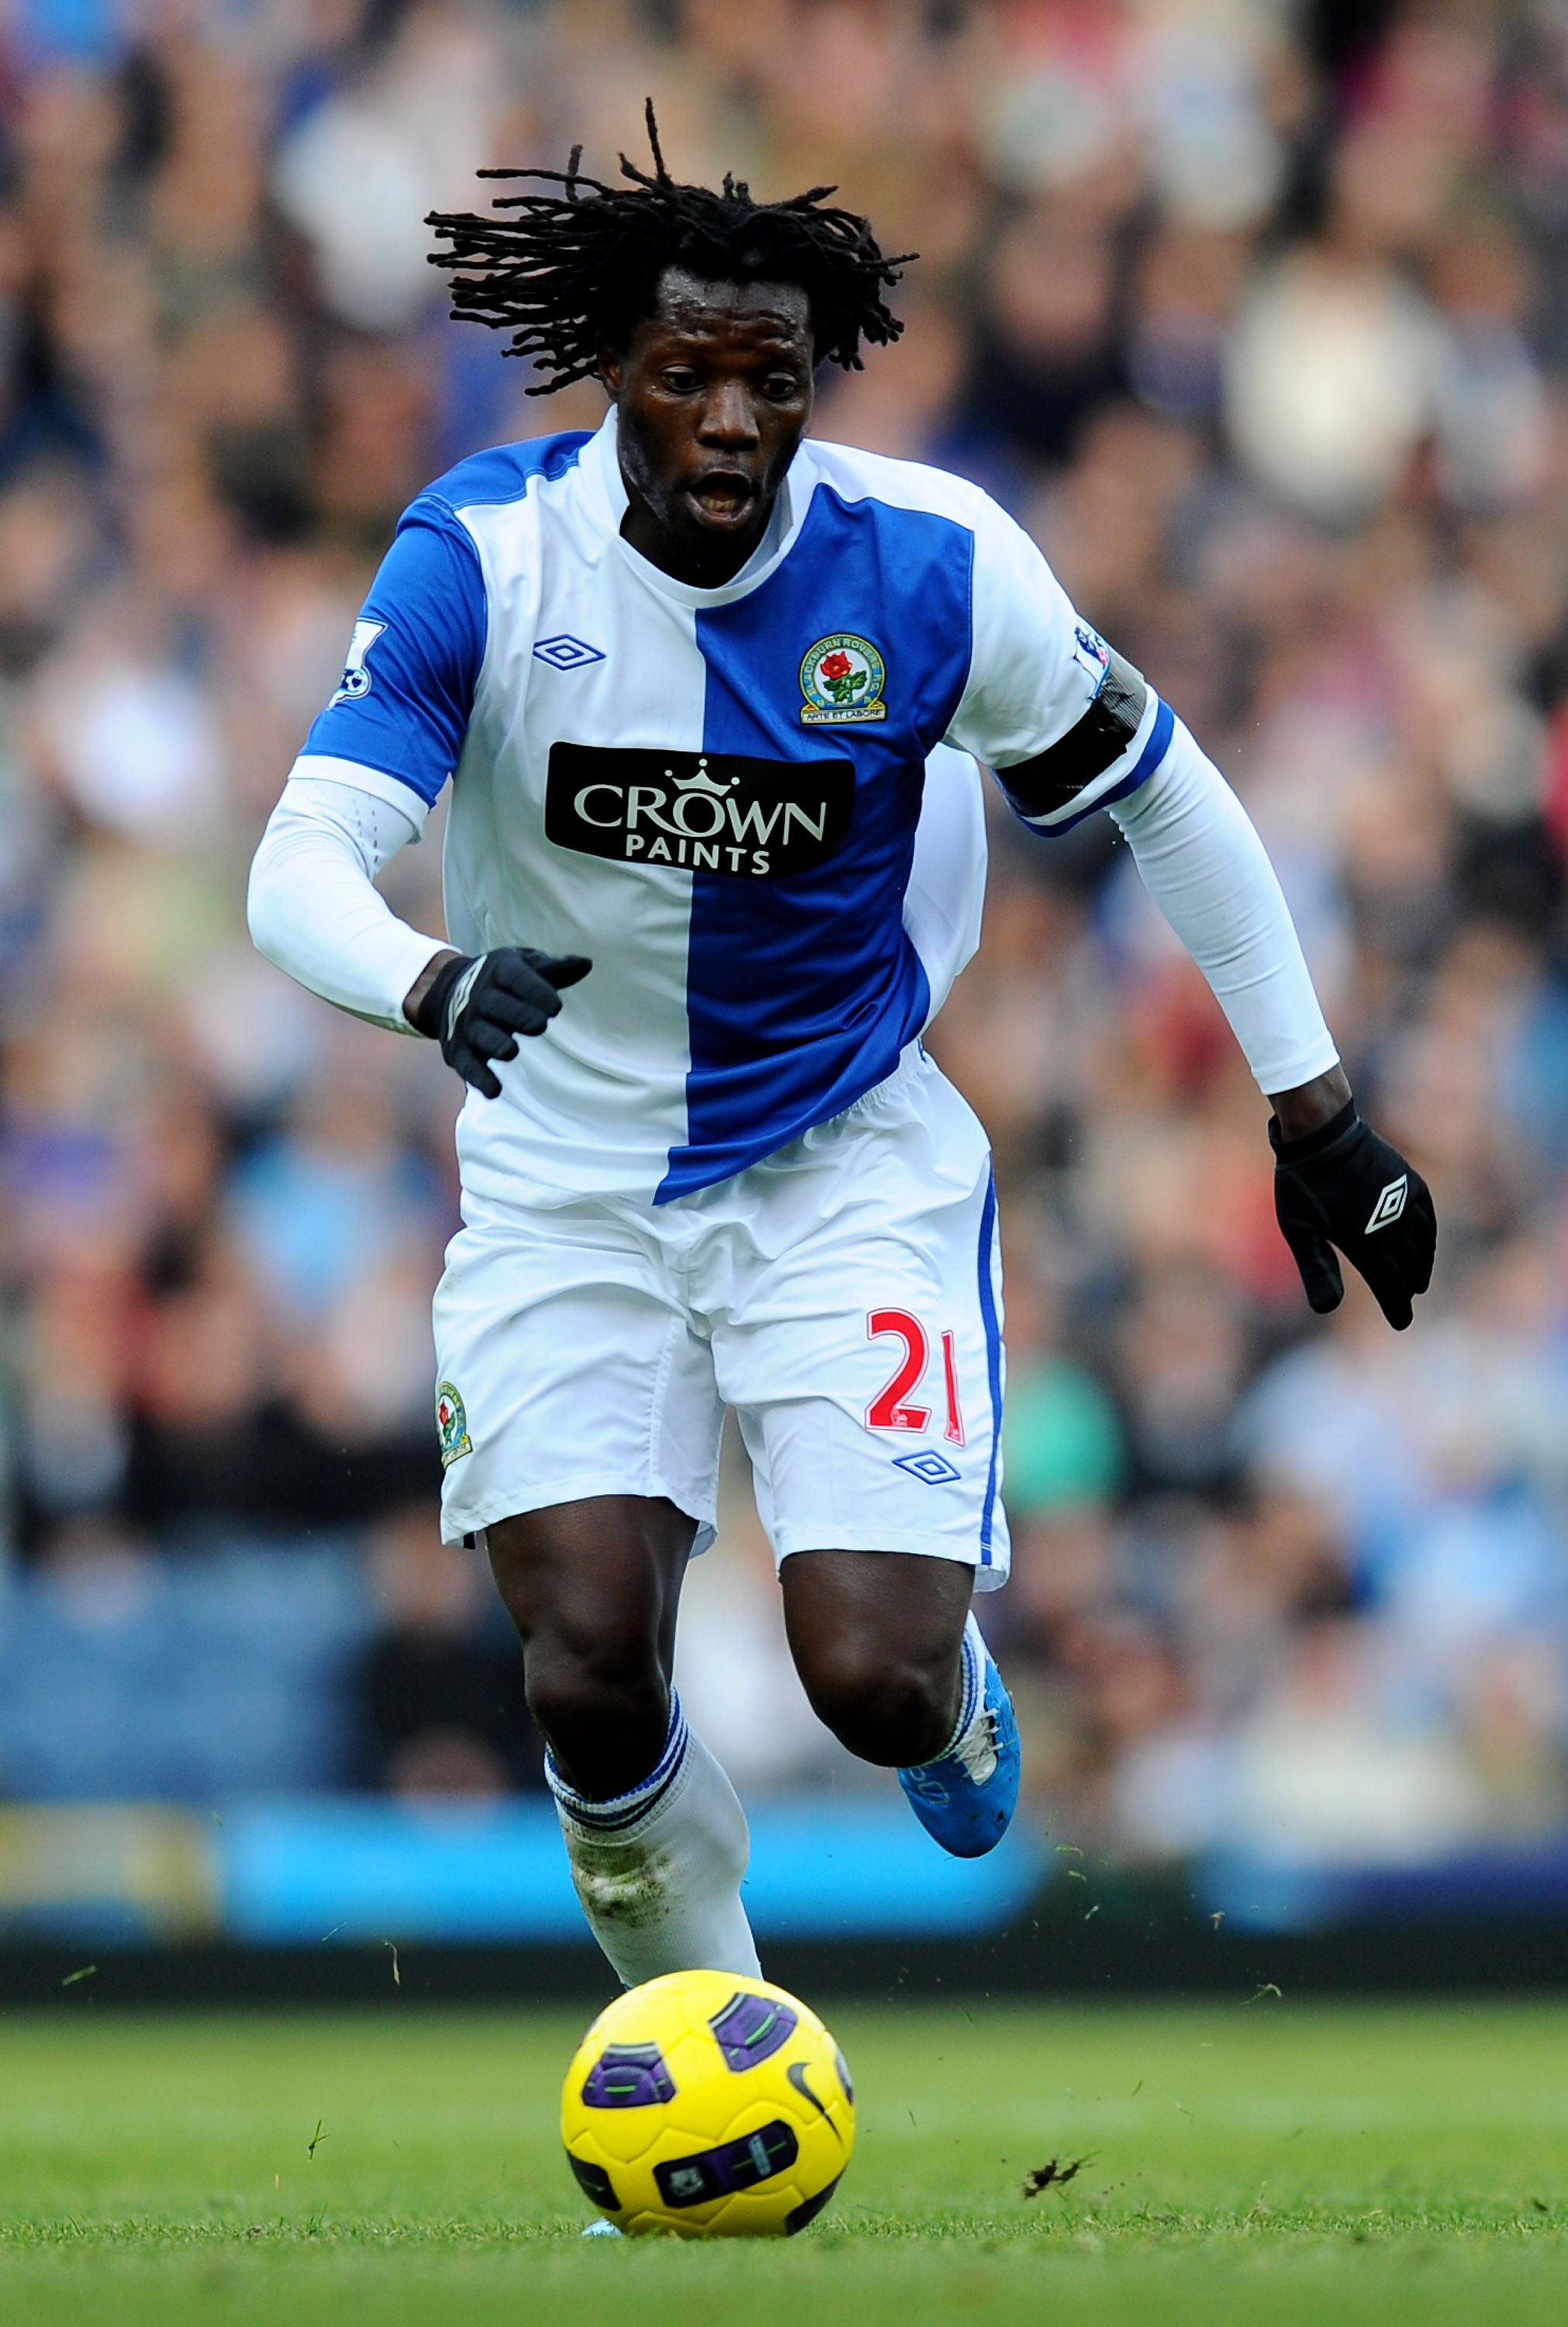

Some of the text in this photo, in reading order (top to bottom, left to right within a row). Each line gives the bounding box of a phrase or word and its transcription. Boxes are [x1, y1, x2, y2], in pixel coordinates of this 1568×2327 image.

[803, 638, 841, 695] BLACKBURN
[843, 638, 880, 669] ROVERS
[807, 709, 882, 721] ARTE ET LABORE
[574, 783, 827, 845] CROWN
[626, 834, 770, 875] PAINTS
[865, 1307, 965, 1447] 21
